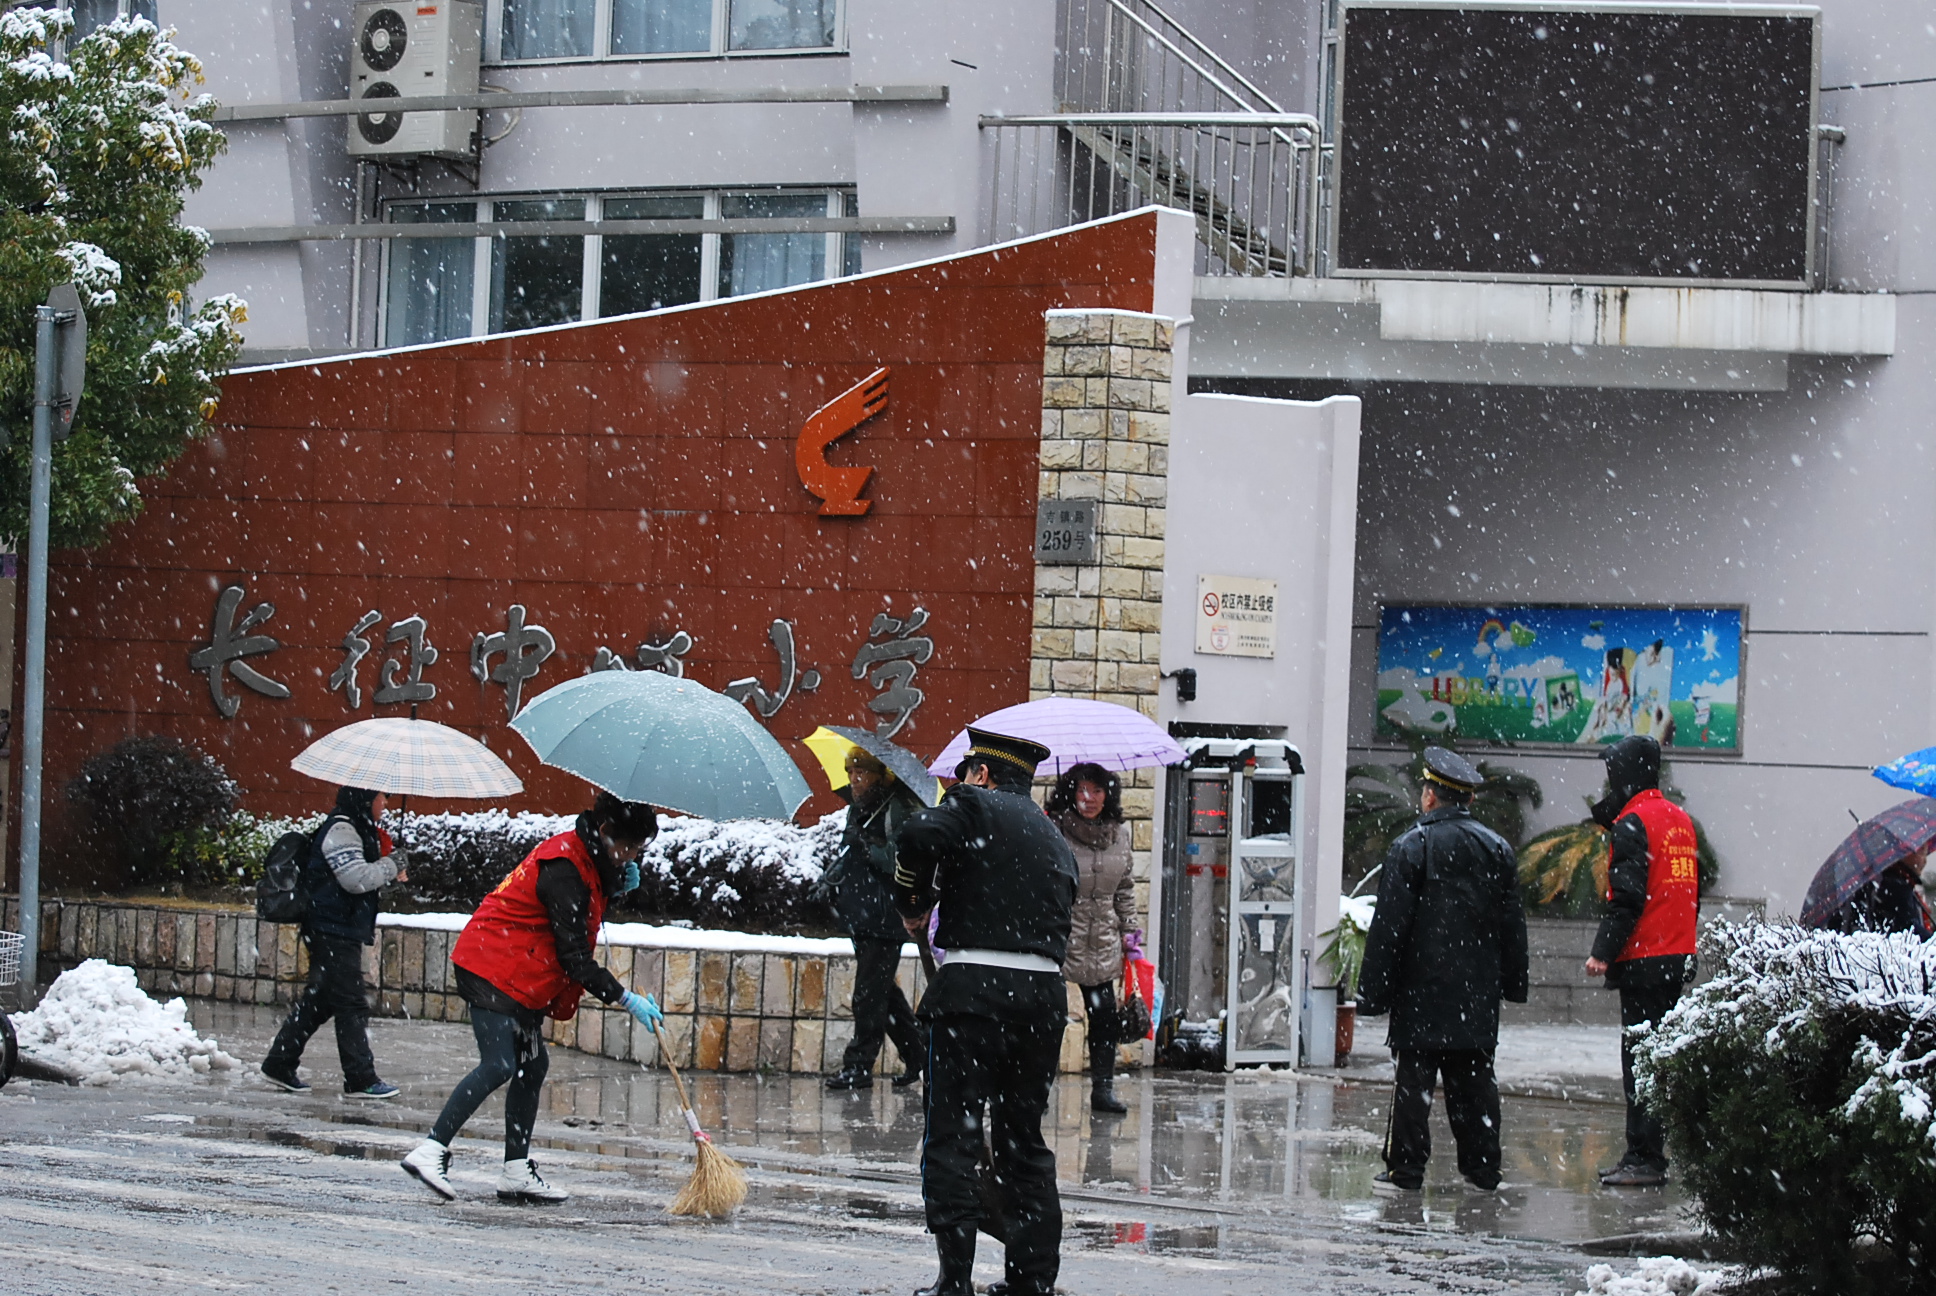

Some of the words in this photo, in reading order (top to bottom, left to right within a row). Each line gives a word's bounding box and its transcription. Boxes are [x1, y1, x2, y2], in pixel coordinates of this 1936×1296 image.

[1041, 530, 1086, 551] 259号
[190, 585, 937, 739] 长征中小学
